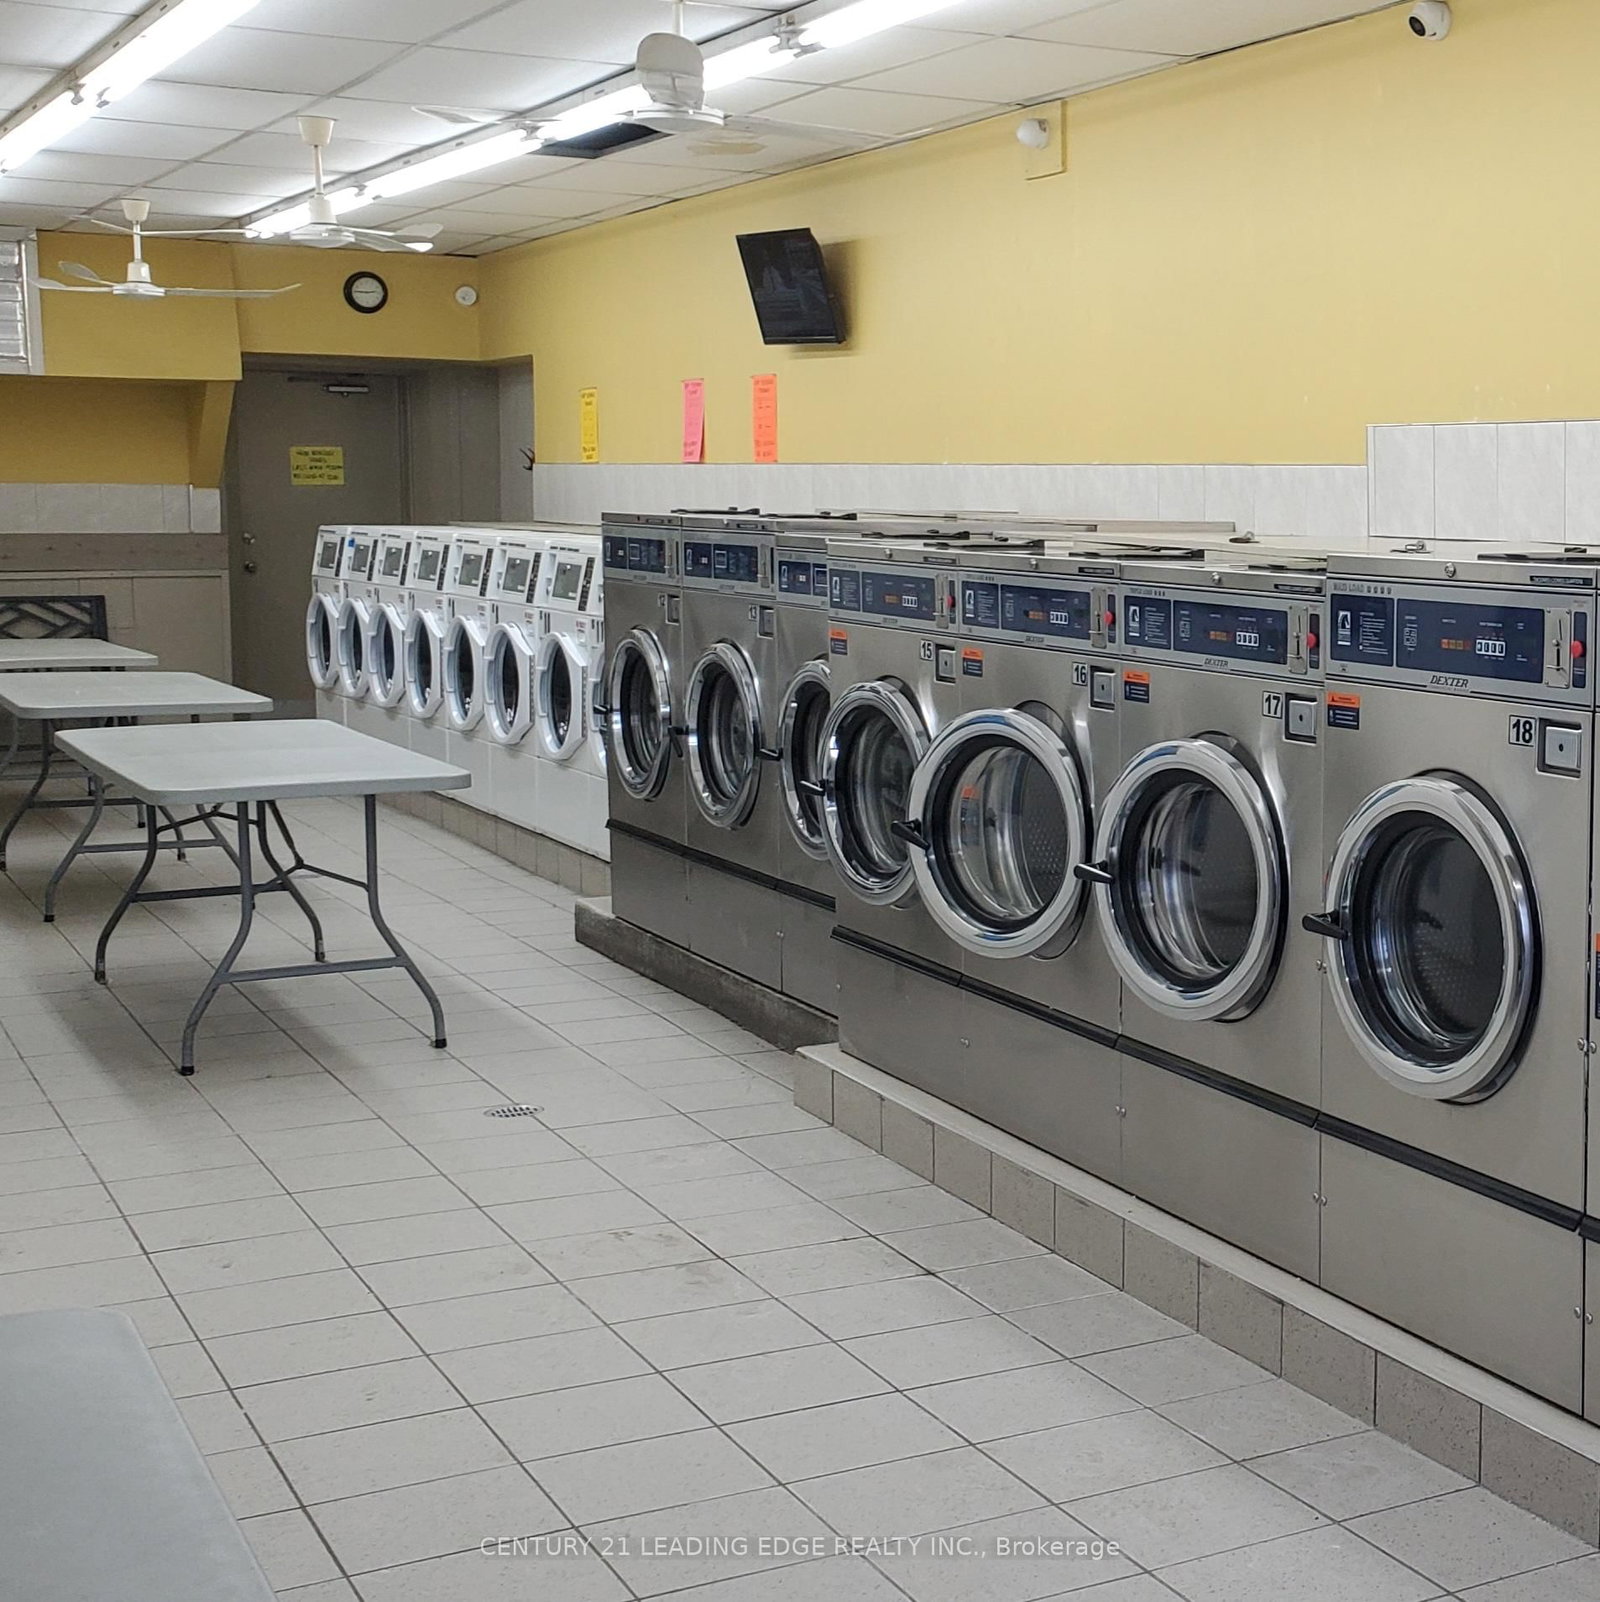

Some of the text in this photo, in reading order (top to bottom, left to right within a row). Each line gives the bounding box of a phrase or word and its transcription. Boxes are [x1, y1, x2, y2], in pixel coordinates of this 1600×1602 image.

[922, 641, 933, 659] 15
[1075, 664, 1087, 684] 16
[1430, 675, 1469, 689] DEXTER
[1265, 694, 1281, 716] 17
[1512, 718, 1533, 743] 18
